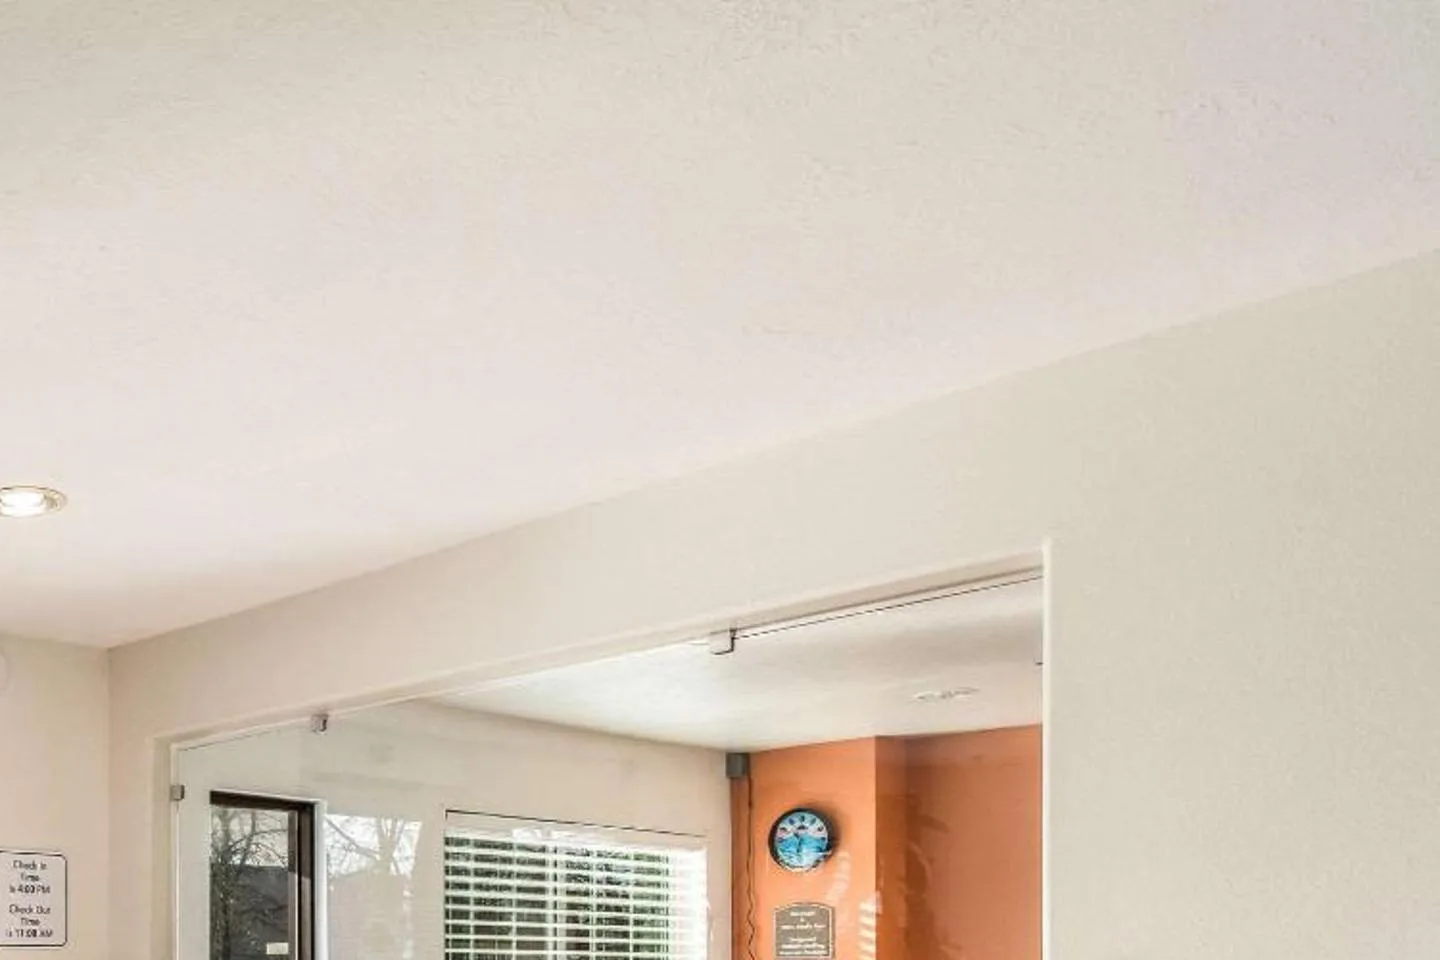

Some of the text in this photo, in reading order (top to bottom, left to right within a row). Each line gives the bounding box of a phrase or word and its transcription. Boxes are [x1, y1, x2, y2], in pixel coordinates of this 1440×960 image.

[13, 860, 37, 870] Check
[20, 872, 40, 882] Time
[17, 885, 35, 894] 4:00
[36, 885, 51, 894] PM
[9, 904, 51, 915] Check Out
[20, 917, 40, 926] Time
[16, 929, 37, 938] 11:00
[39, 929, 53, 938] AM
